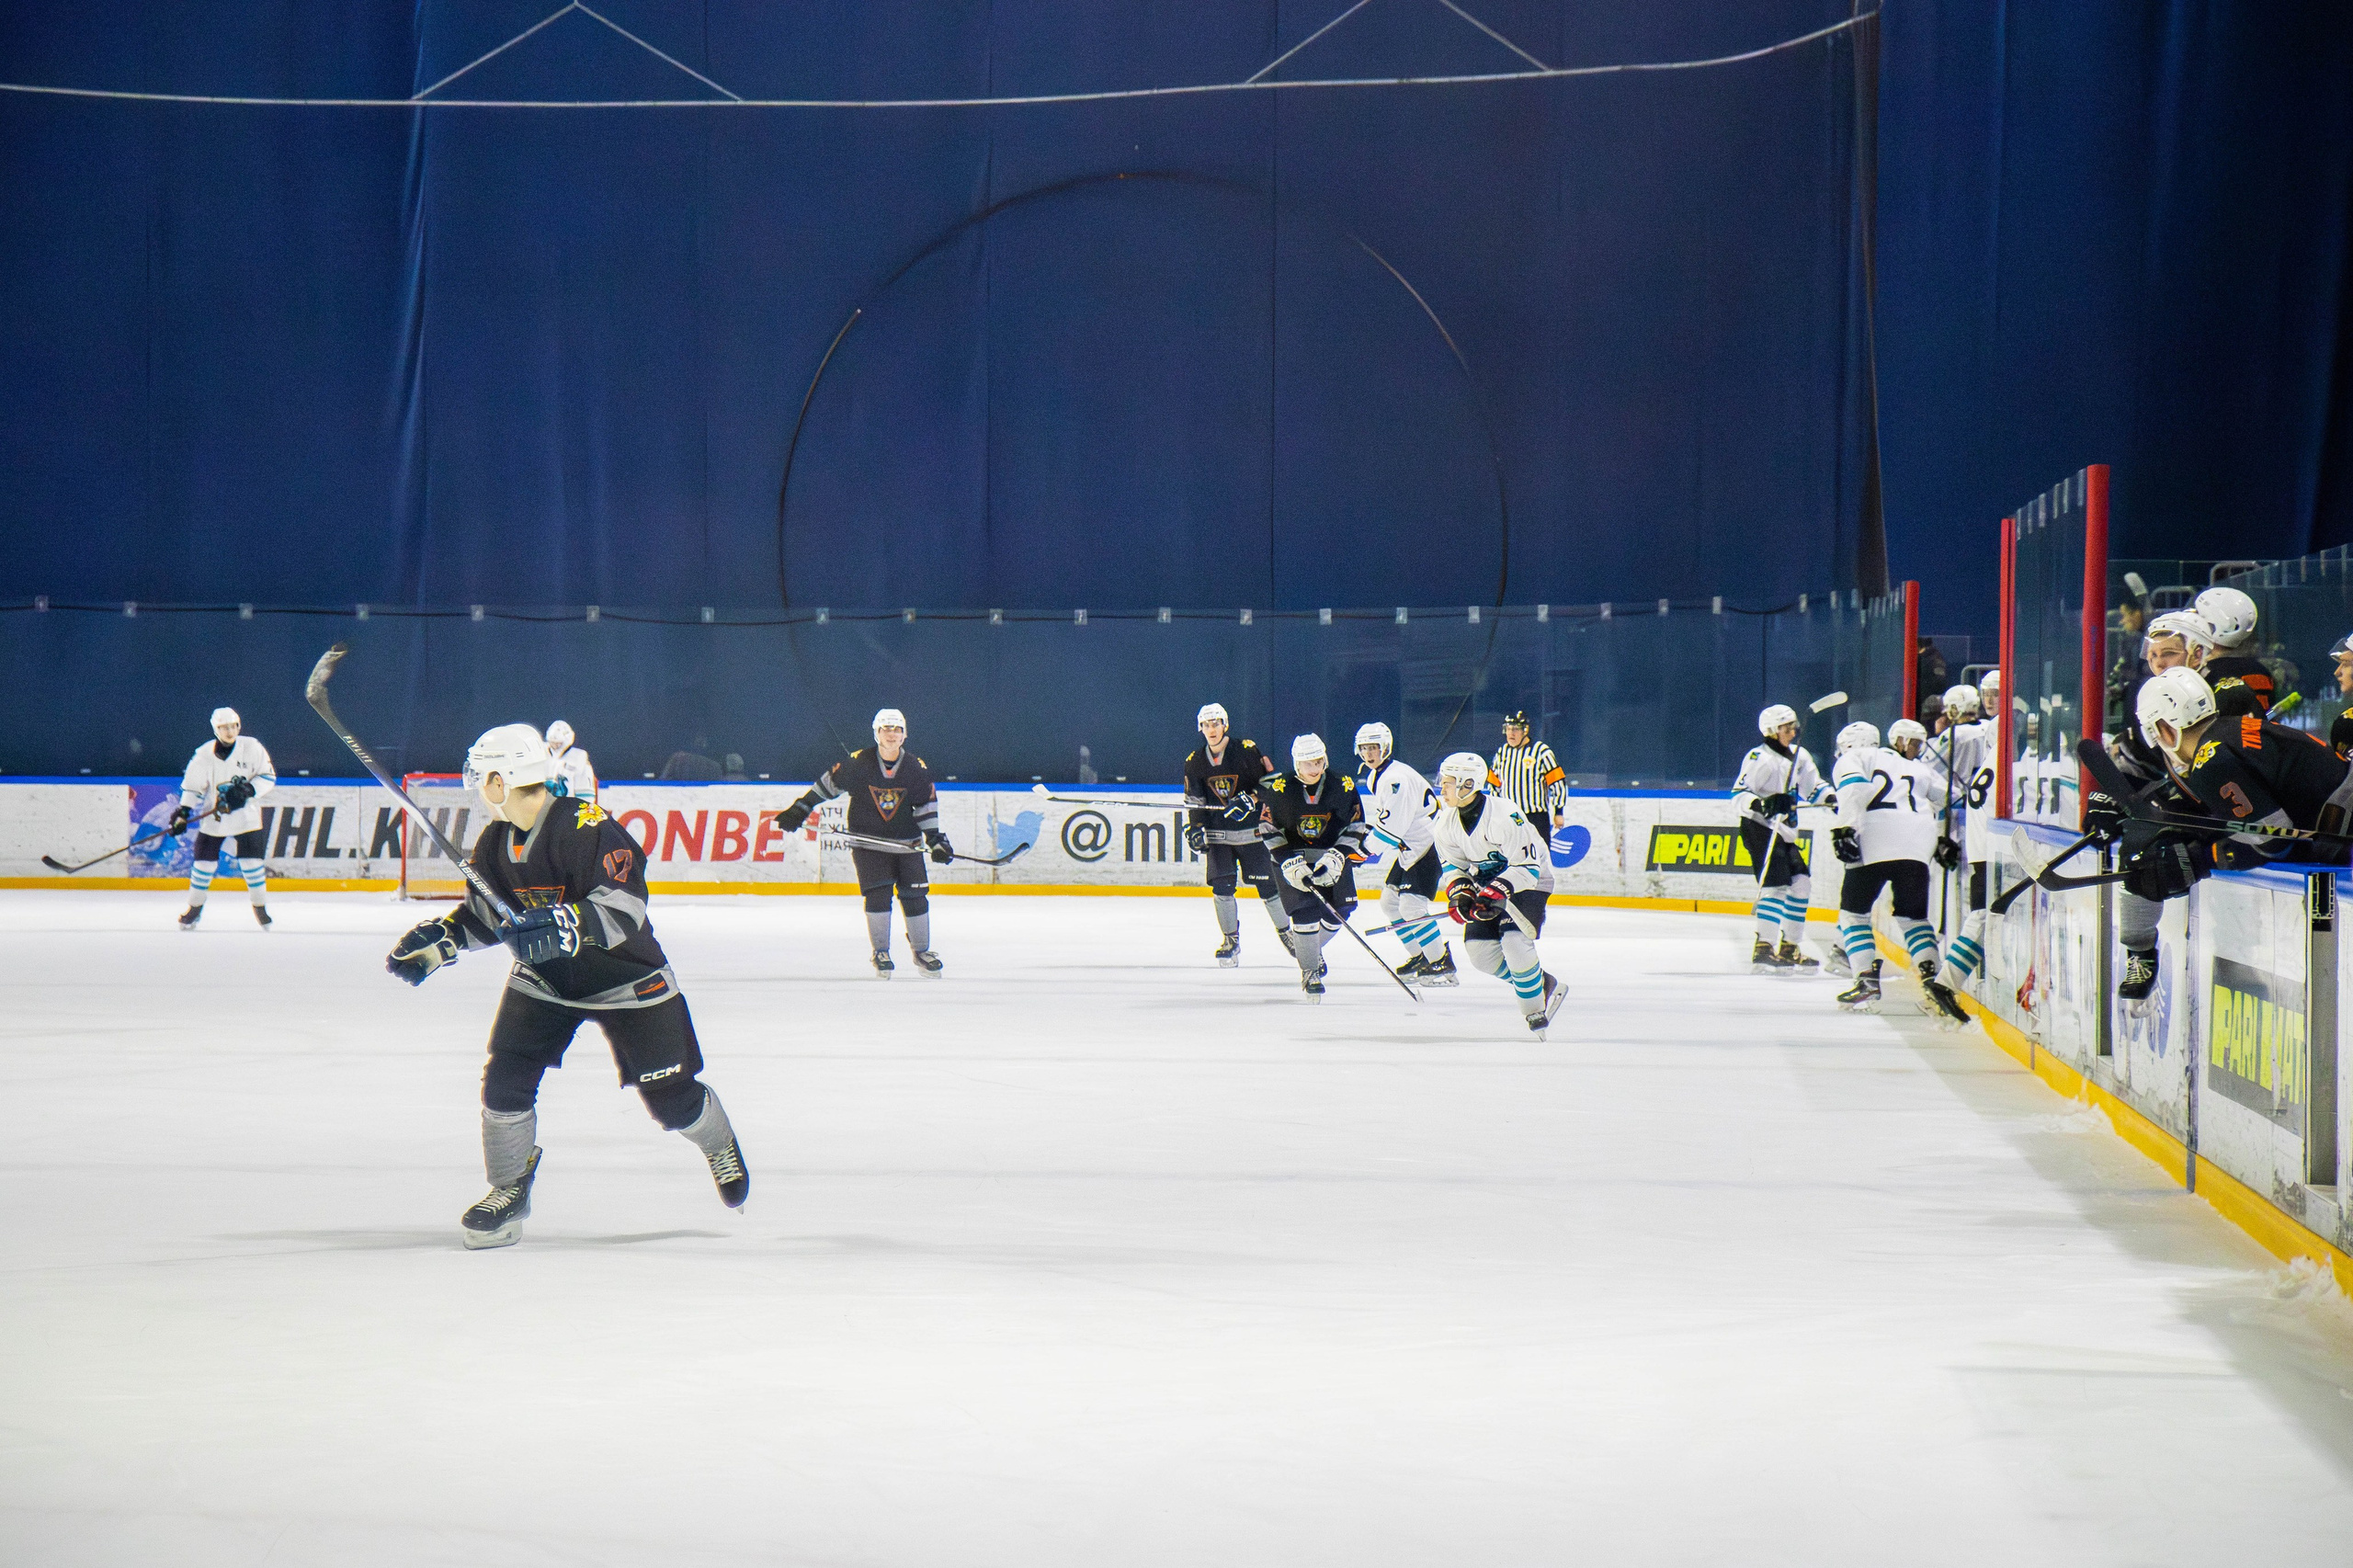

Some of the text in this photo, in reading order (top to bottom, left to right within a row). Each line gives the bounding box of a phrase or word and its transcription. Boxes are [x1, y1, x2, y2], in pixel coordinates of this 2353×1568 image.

[2219, 781, 2254, 818] 3
[820, 839, 851, 851] НАЯ
[603, 848, 632, 882] 17
[460, 866, 493, 896] BAUER
[639, 1063, 681, 1083] CCM
